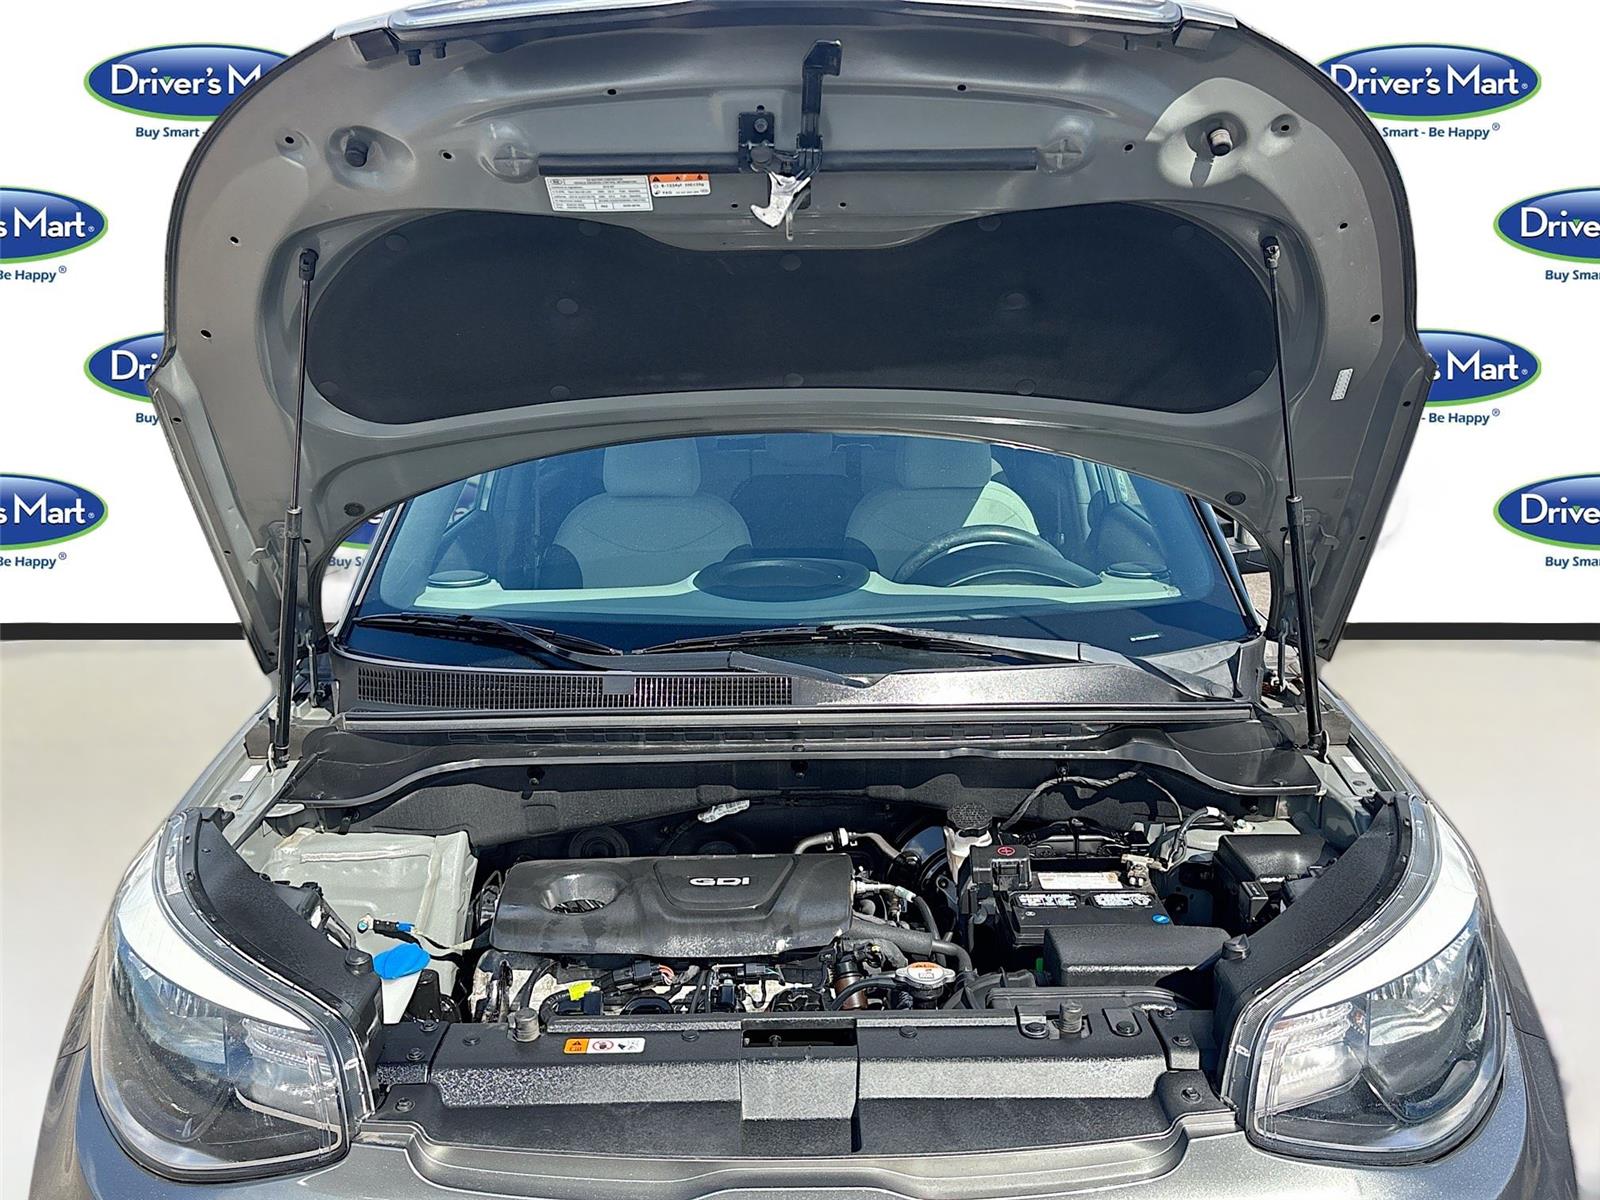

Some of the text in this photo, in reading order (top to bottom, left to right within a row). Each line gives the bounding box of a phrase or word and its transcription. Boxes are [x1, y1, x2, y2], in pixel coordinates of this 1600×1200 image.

[111, 64, 222, 95] Driver's
[1330, 63, 1519, 95] Driver's Mart
[136, 127, 160, 140] Buy
[163, 127, 200, 137] Smart
[1382, 127, 1419, 137] Smart
[1429, 127, 1445, 137] Be
[1448, 127, 1490, 140] Happy
[14, 206, 86, 238] Mart
[1520, 206, 1600, 238] Drive
[15, 270, 57, 283] Happy
[1545, 270, 1600, 283] Buy Sma
[1447, 349, 1519, 381] Mart
[136, 413, 159, 426] Buy
[1428, 413, 1445, 423] Be
[1448, 413, 1490, 426] Happy
[14, 493, 86, 524] Mart
[1520, 493, 1600, 524] Drive
[15, 557, 57, 569] Happy
[328, 557, 352, 569] Buy
[1545, 557, 1600, 569] Buy Sma
[689, 877, 750, 886] GDI
